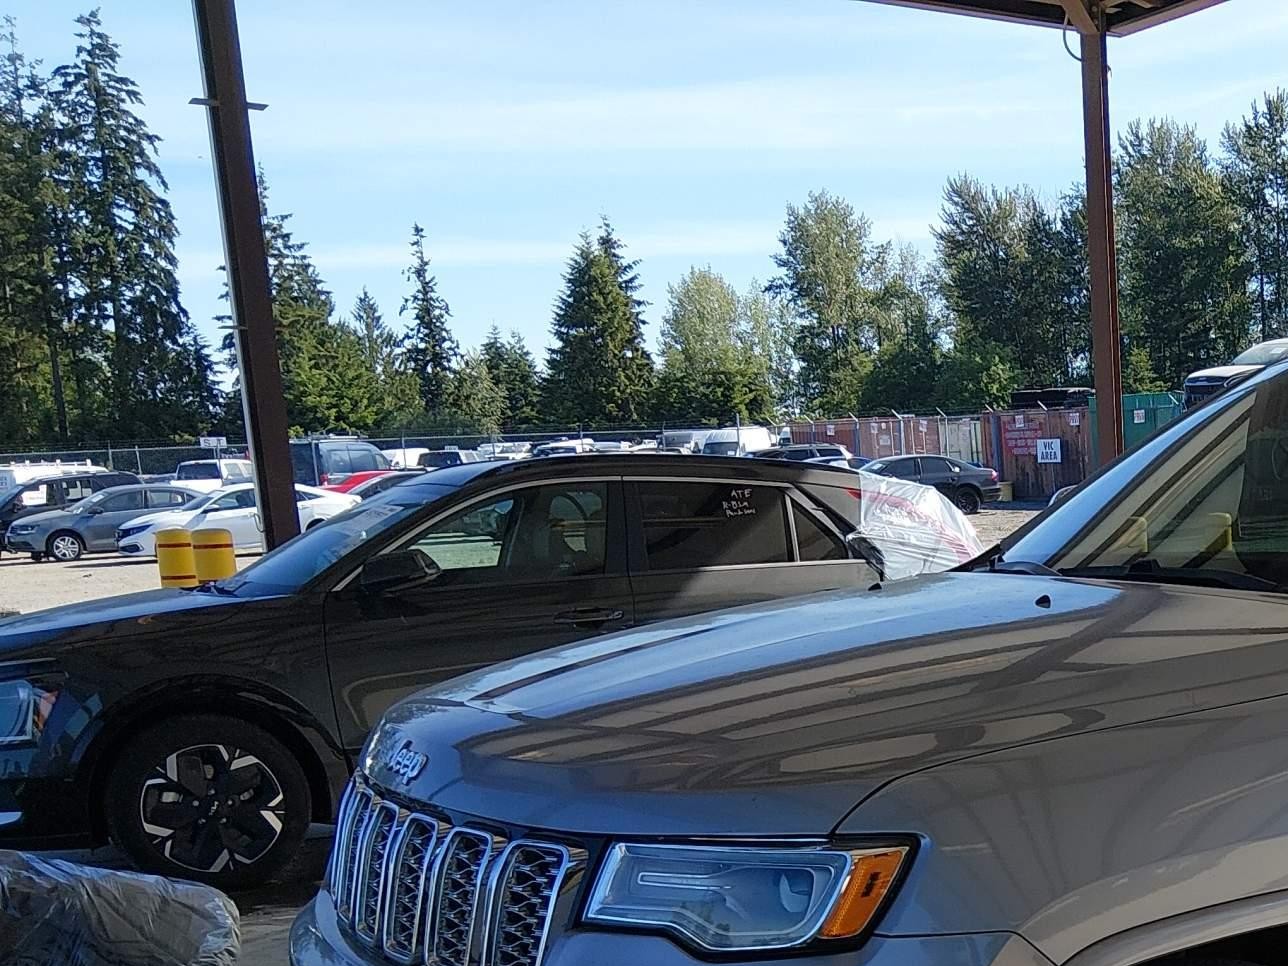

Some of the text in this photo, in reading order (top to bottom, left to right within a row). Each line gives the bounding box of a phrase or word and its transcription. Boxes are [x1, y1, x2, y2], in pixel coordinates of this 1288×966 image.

[1043, 440, 1054, 451] VIC
[1040, 450, 1058, 461] AREA
[387, 739, 430, 786] Jeep
